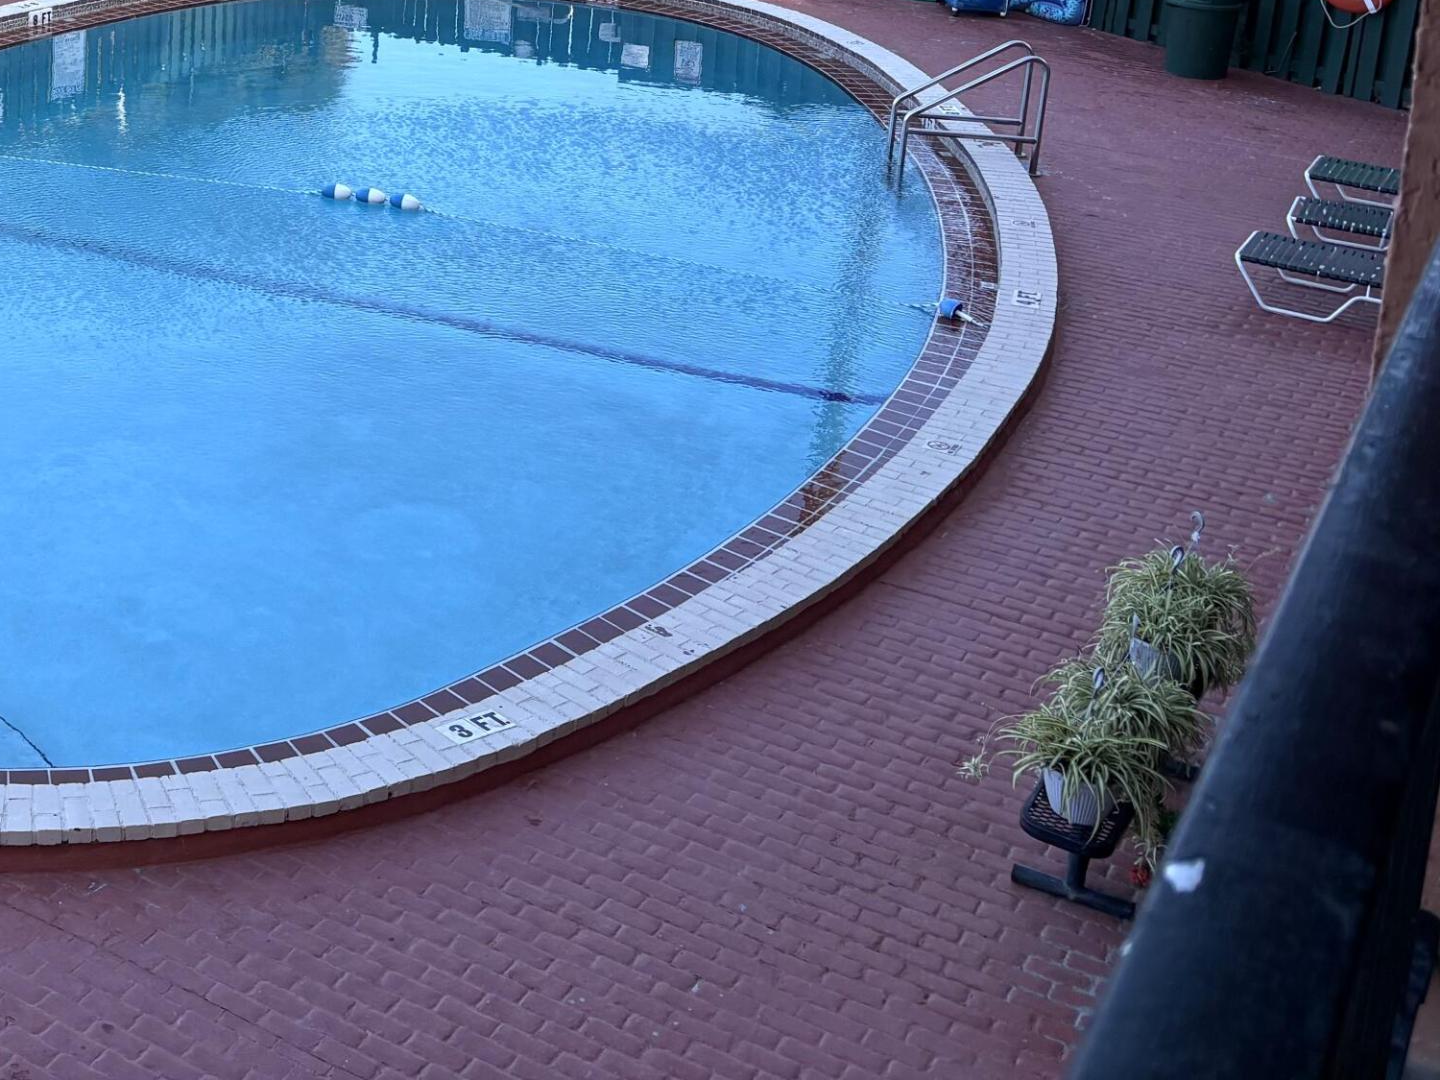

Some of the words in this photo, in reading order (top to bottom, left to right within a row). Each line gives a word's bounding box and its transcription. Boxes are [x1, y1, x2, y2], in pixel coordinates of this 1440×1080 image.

[33, 14, 38, 26] 8
[41, 11, 51, 24] FT
[449, 724, 474, 738] 3
